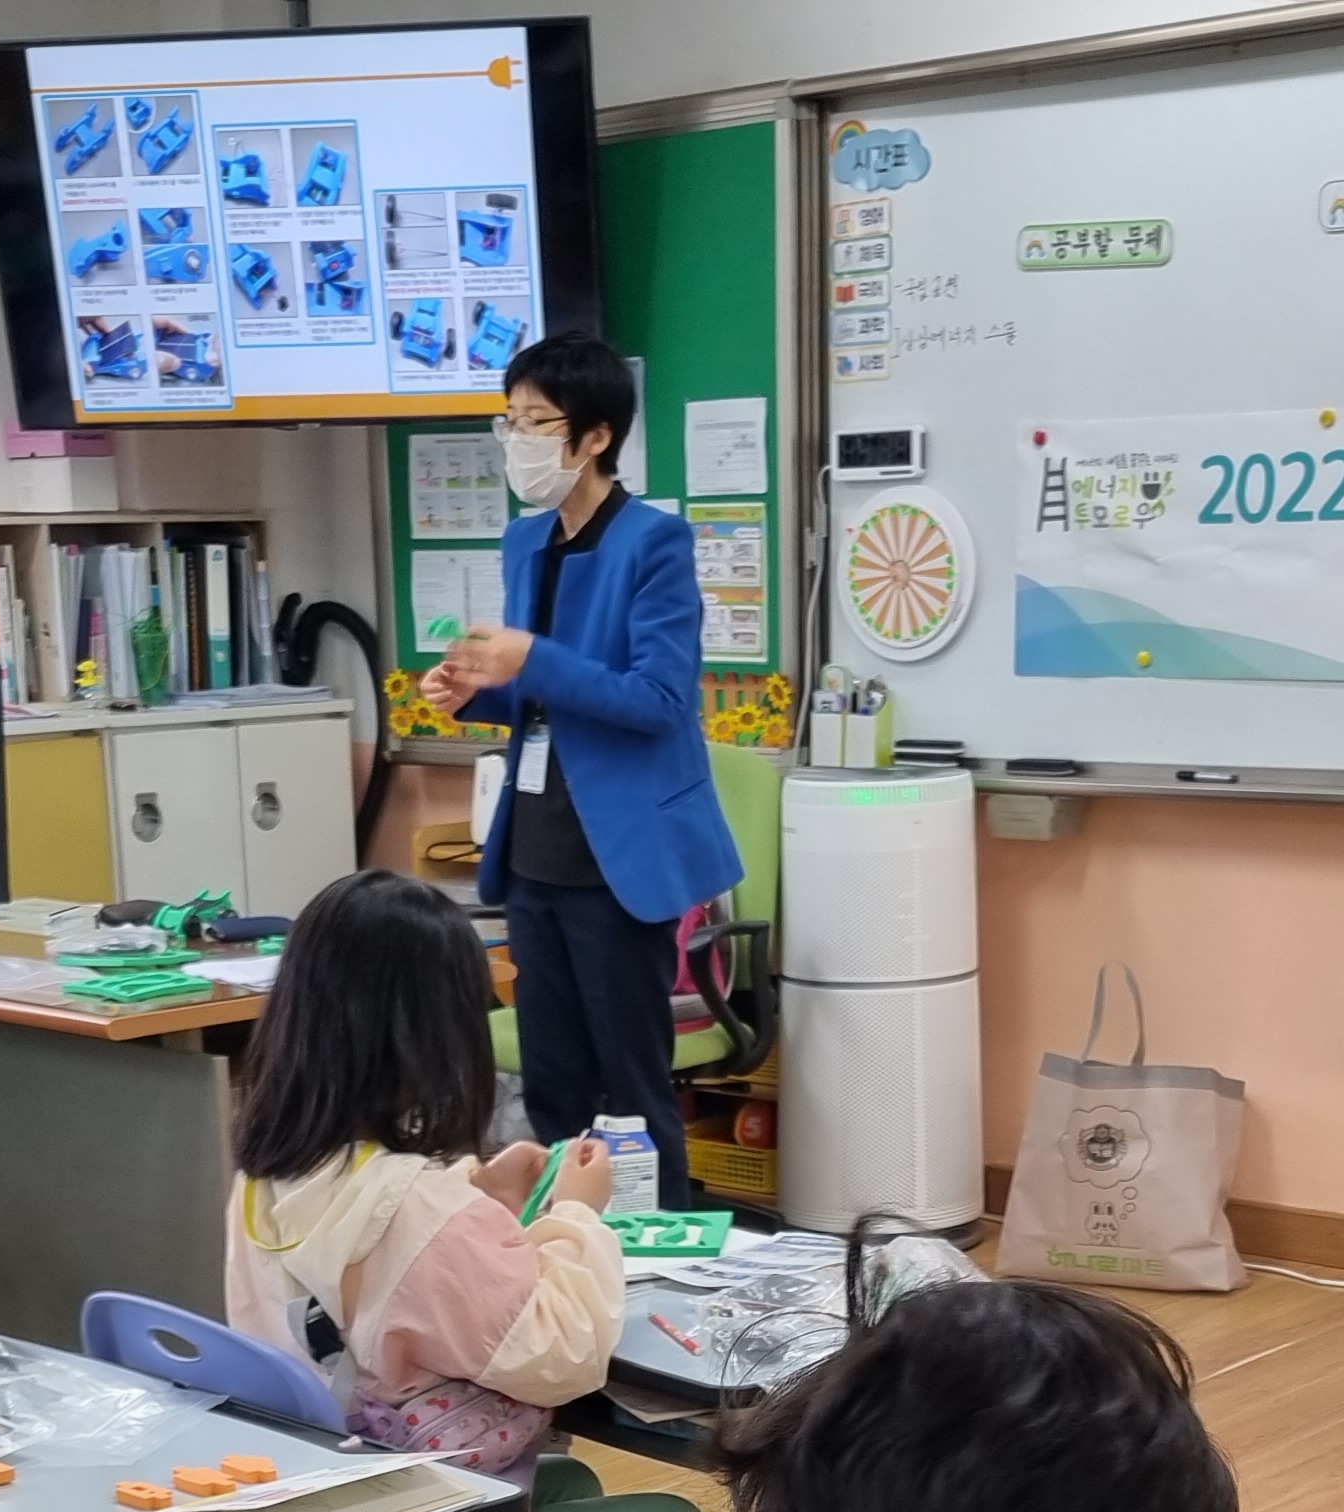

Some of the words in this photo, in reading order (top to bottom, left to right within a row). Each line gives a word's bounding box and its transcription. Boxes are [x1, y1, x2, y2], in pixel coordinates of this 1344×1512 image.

[853, 143, 909, 174] 시간표
[1050, 226, 1115, 259] 공부할
[1122, 224, 1164, 257] 문제
[1072, 474, 1137, 499] 에너지
[1074, 502, 1156, 531] 투모로우
